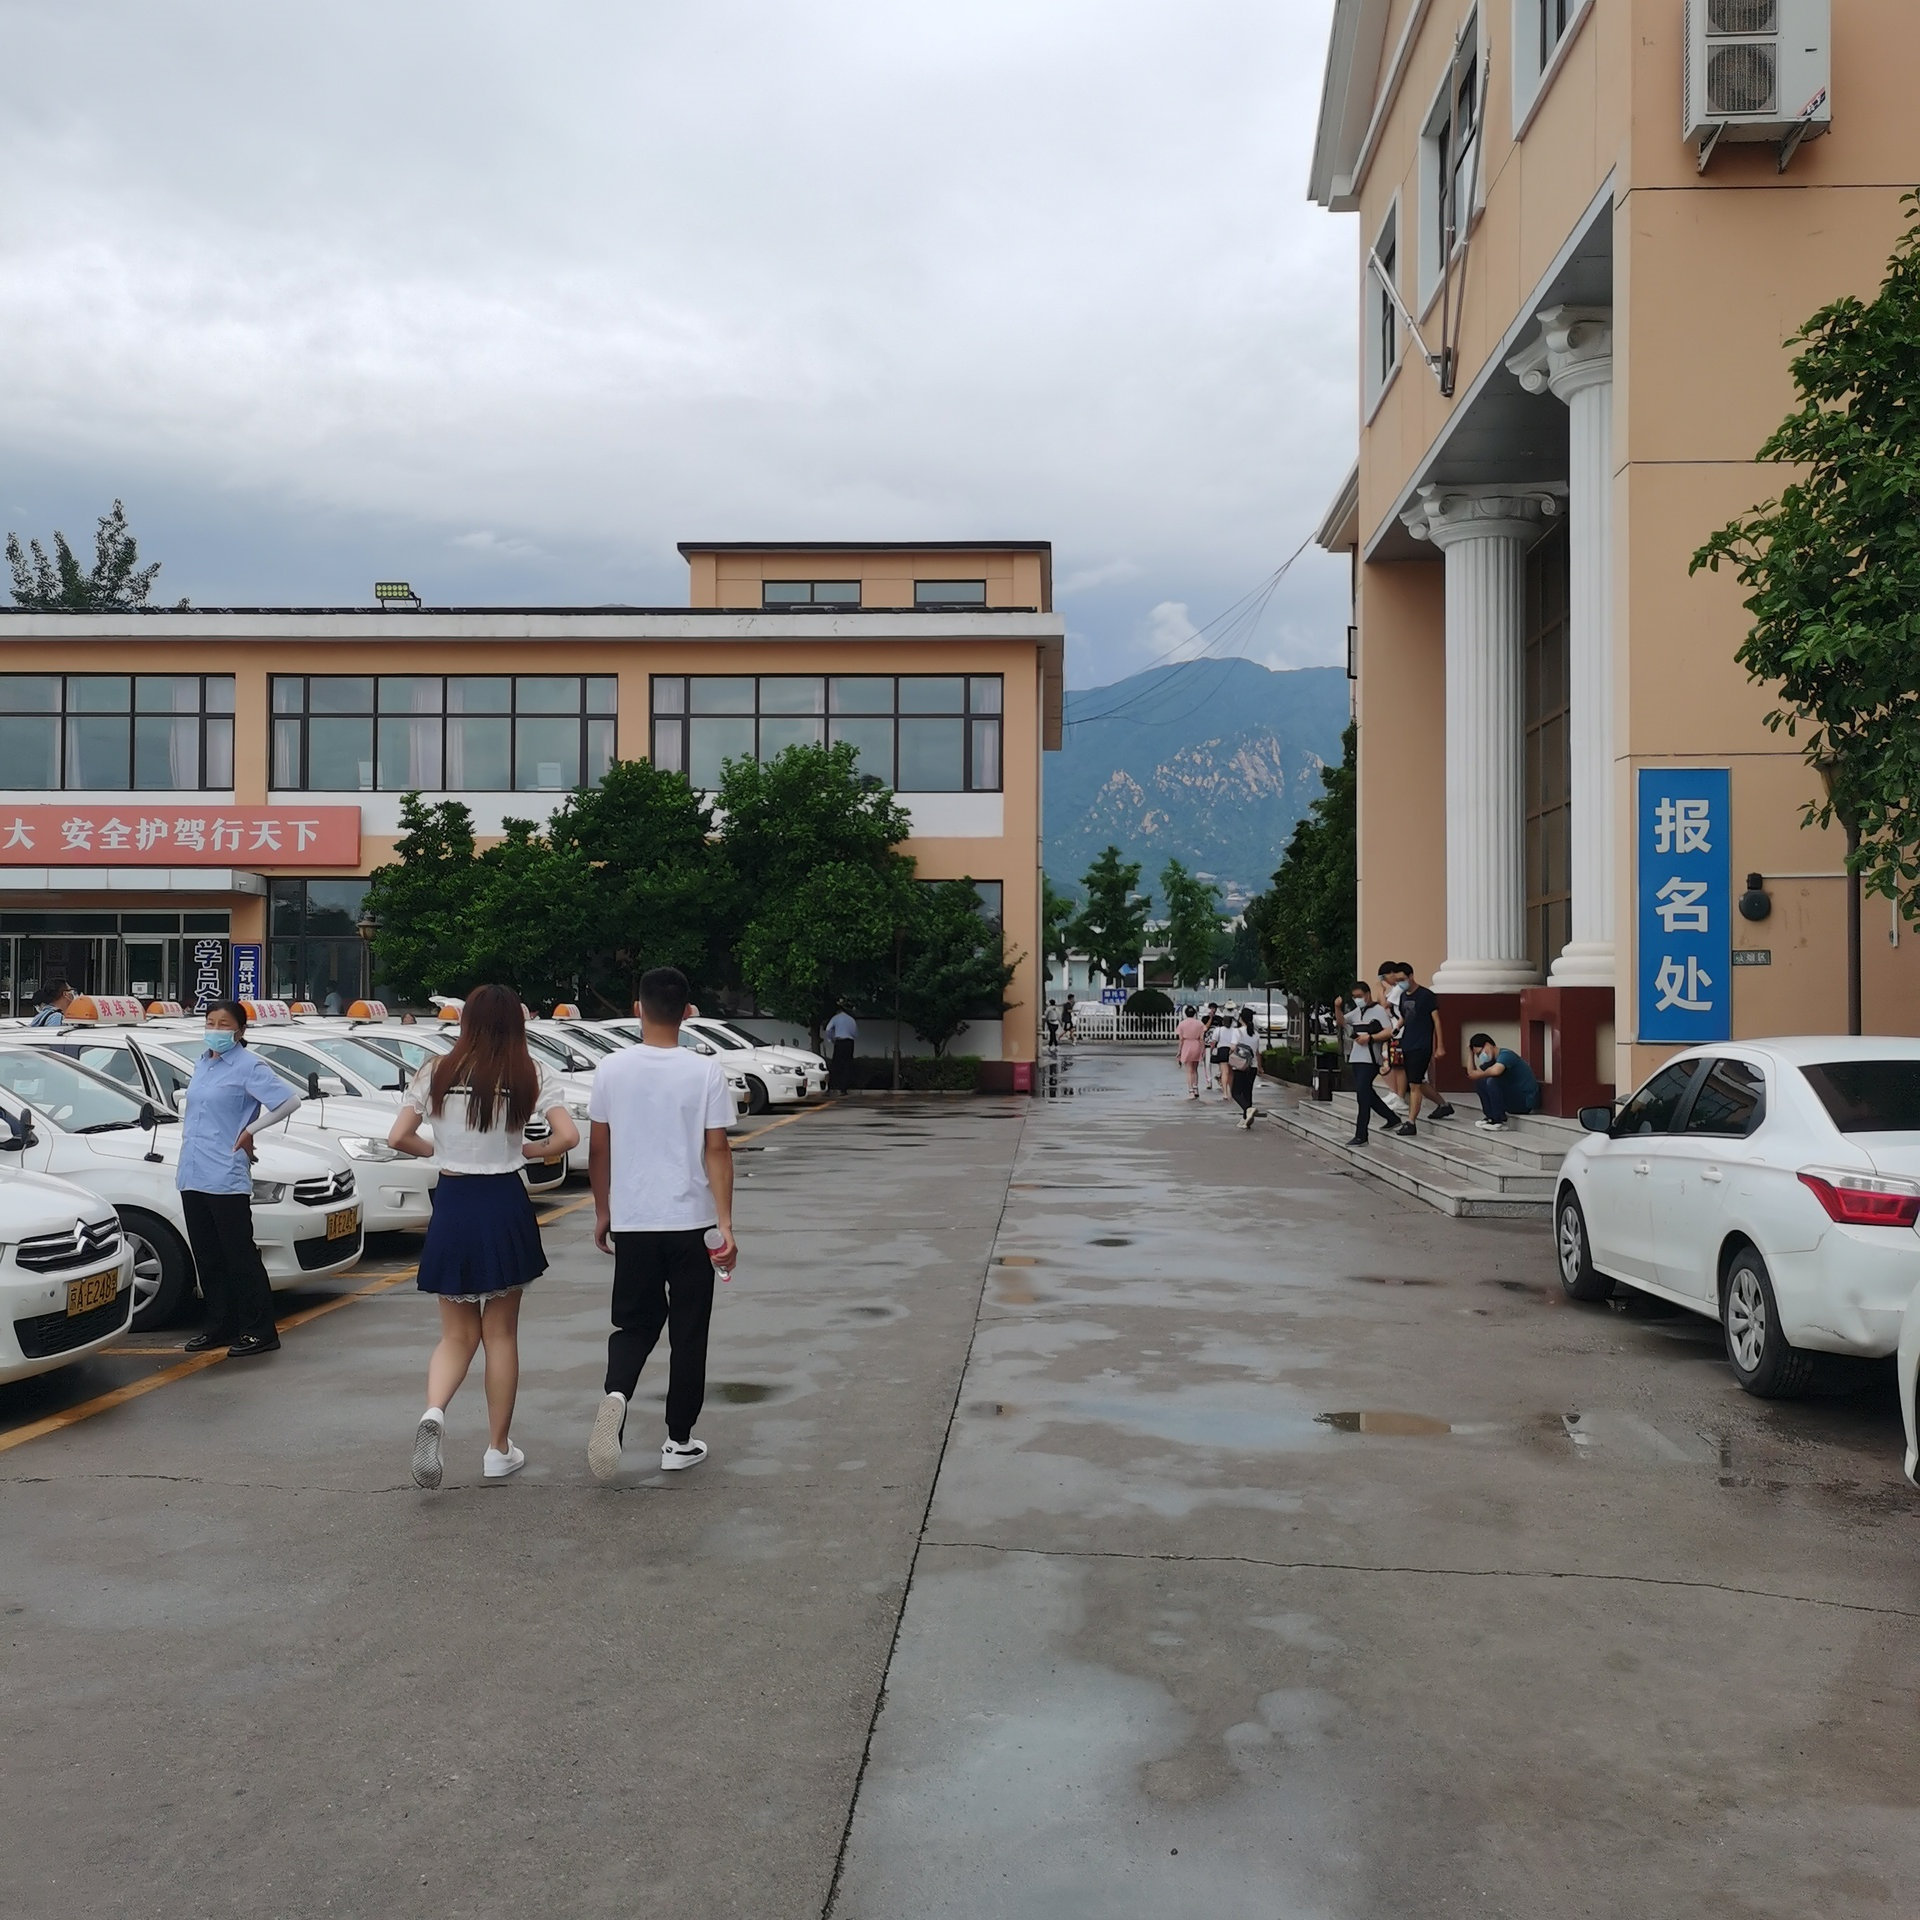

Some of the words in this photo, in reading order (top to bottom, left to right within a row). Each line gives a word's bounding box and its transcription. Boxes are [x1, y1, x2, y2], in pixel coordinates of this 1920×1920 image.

[2, 817, 36, 851] 大
[60, 817, 320, 852] 安全护驾行天下
[1653, 797, 1713, 1012] 报名处
[98, 999, 140, 1018] 教练车
[256, 1002, 288, 1019] 教练车
